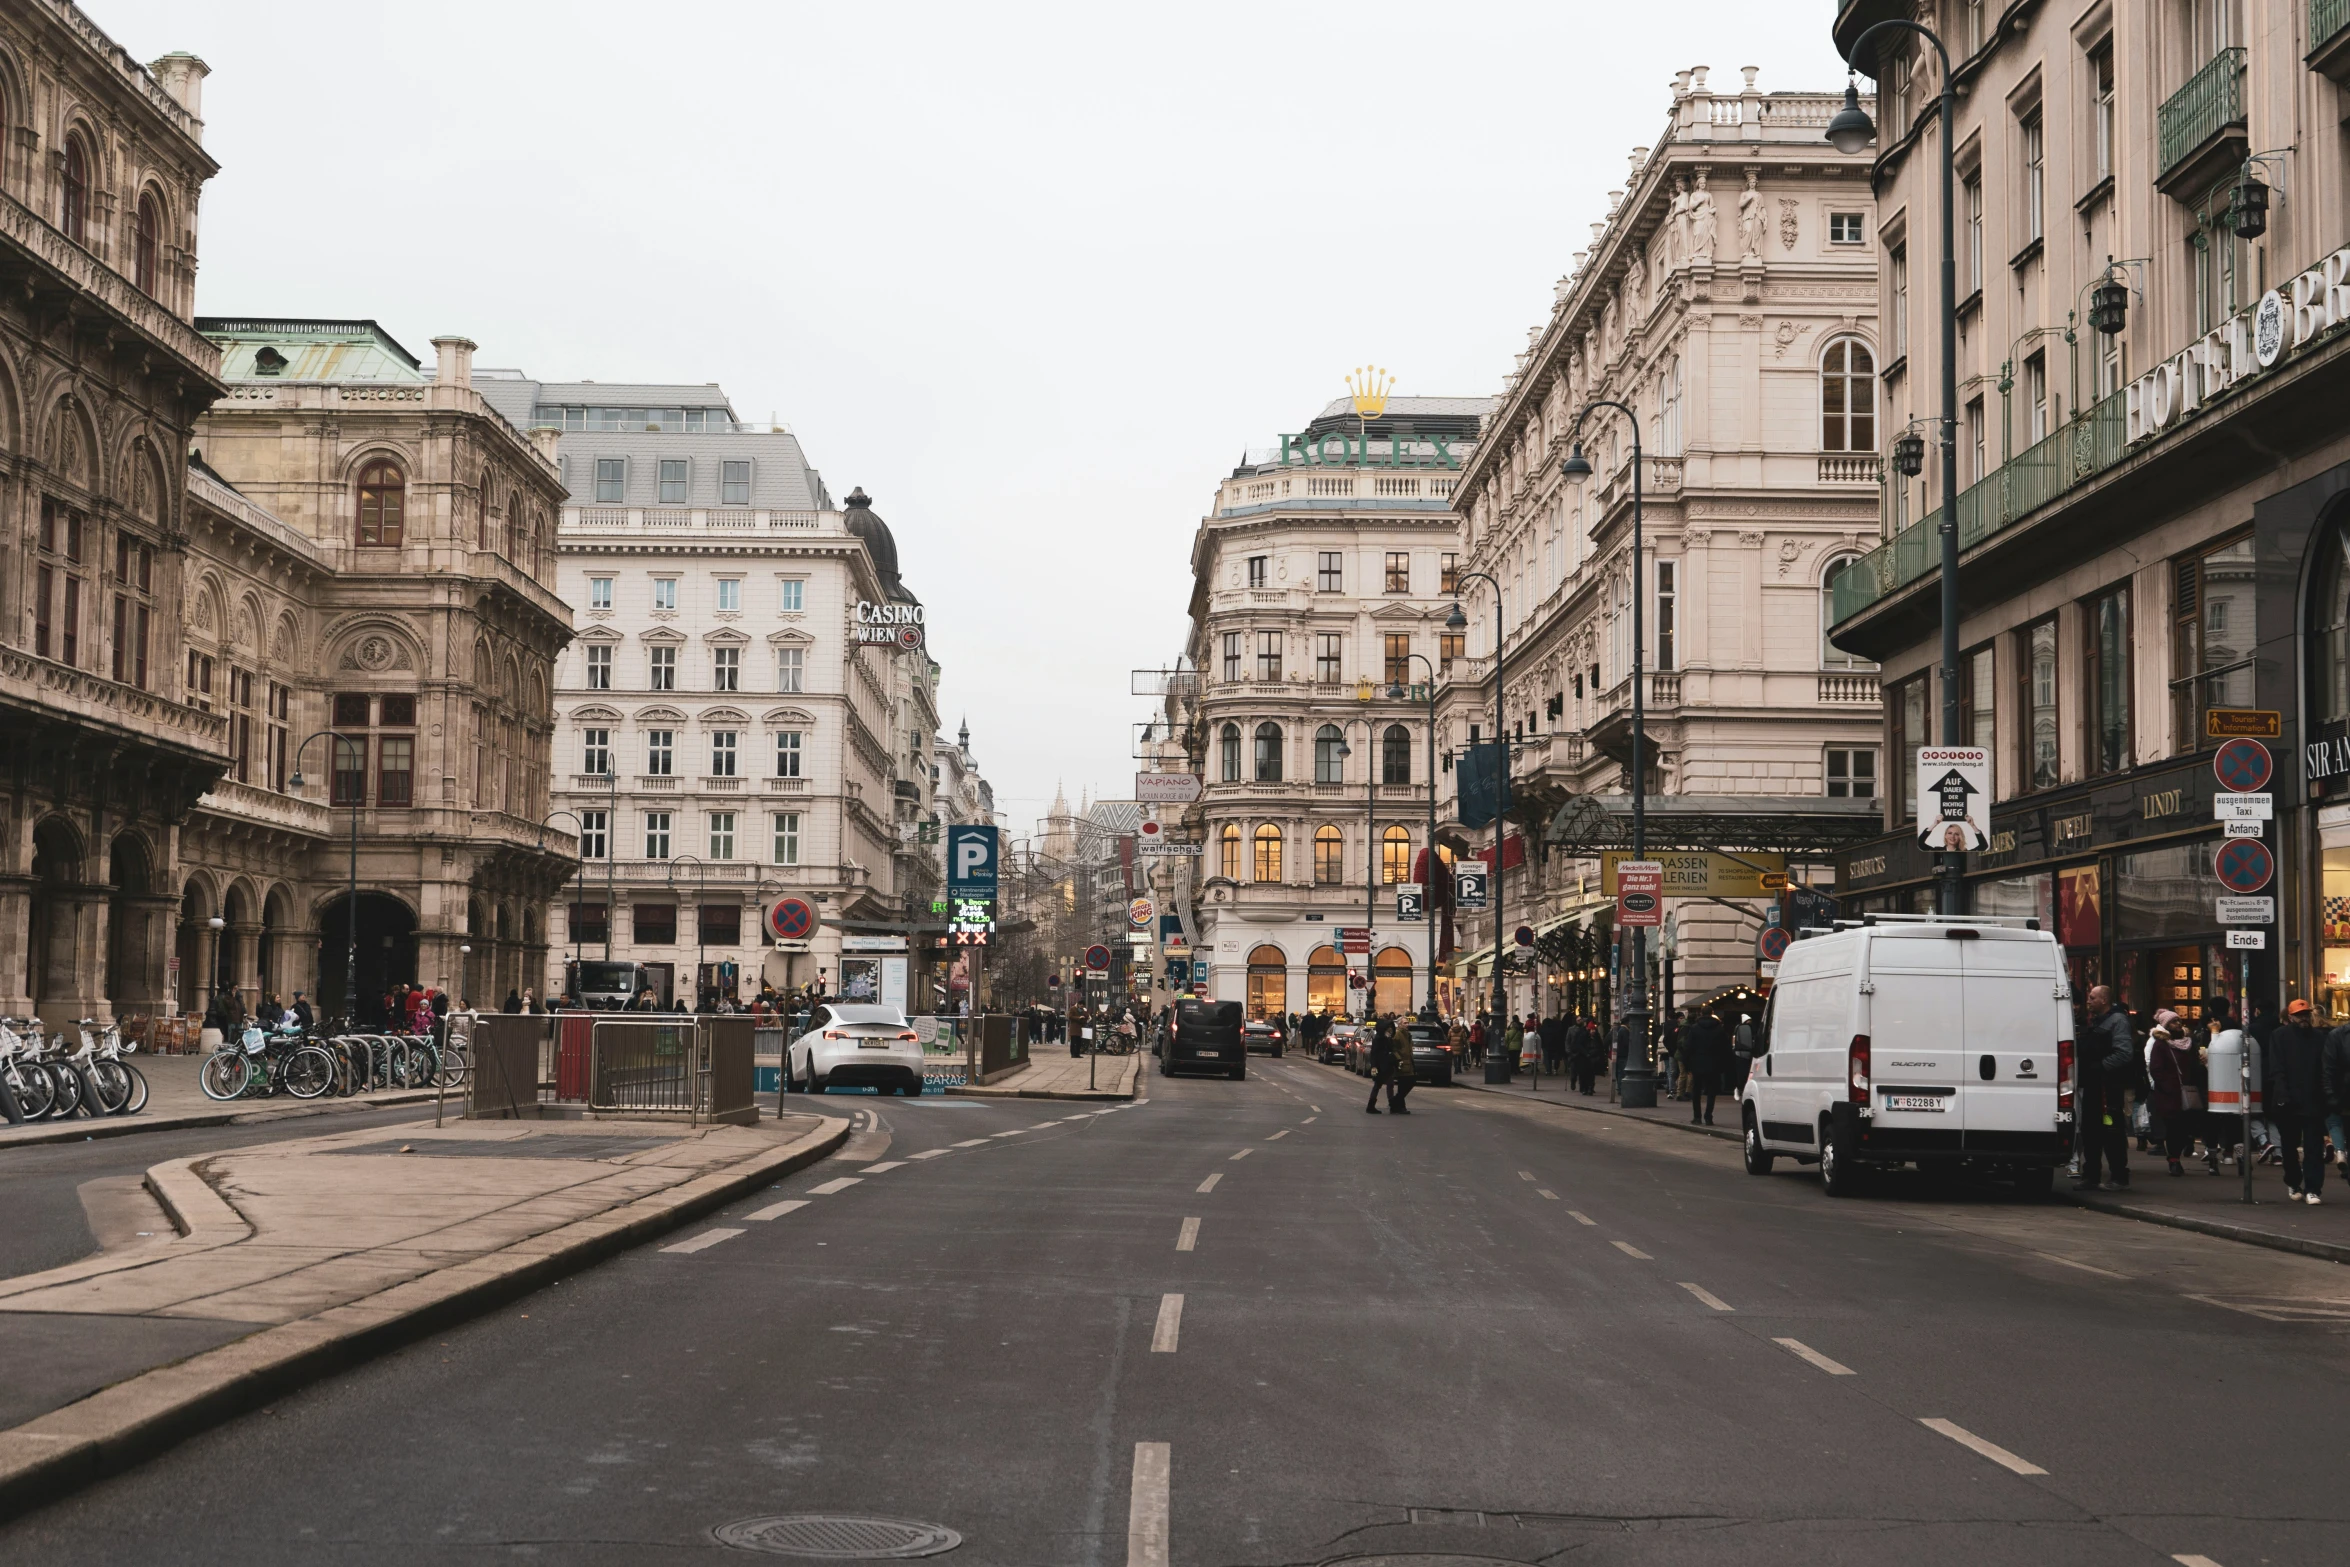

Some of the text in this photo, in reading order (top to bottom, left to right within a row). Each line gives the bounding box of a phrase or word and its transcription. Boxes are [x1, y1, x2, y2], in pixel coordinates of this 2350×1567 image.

[2124, 313, 2261, 447] HOTEL
[1277, 433, 1460, 469] ROLEX
[857, 600, 926, 624] CASINO
[857, 627, 896, 643] WIEN
[2231, 715, 2259, 723] Tourist-
[2223, 724, 2266, 732] Information
[2307, 742, 2331, 779] SIR
[2143, 789, 2182, 819] LINDT
[2216, 797, 2270, 806] ausgenommen
[2236, 806, 2252, 815] Taxi
[2228, 824, 2259, 836] Anfang
[1849, 855, 1885, 879] STARBUCKS
[1130, 903, 1151, 913] BURGER
[1131, 908, 1152, 919] KING
[960, 921, 985, 932] Neuer
[2233, 935, 2258, 945] Ende
[924, 1076, 967, 1085] GARAG
